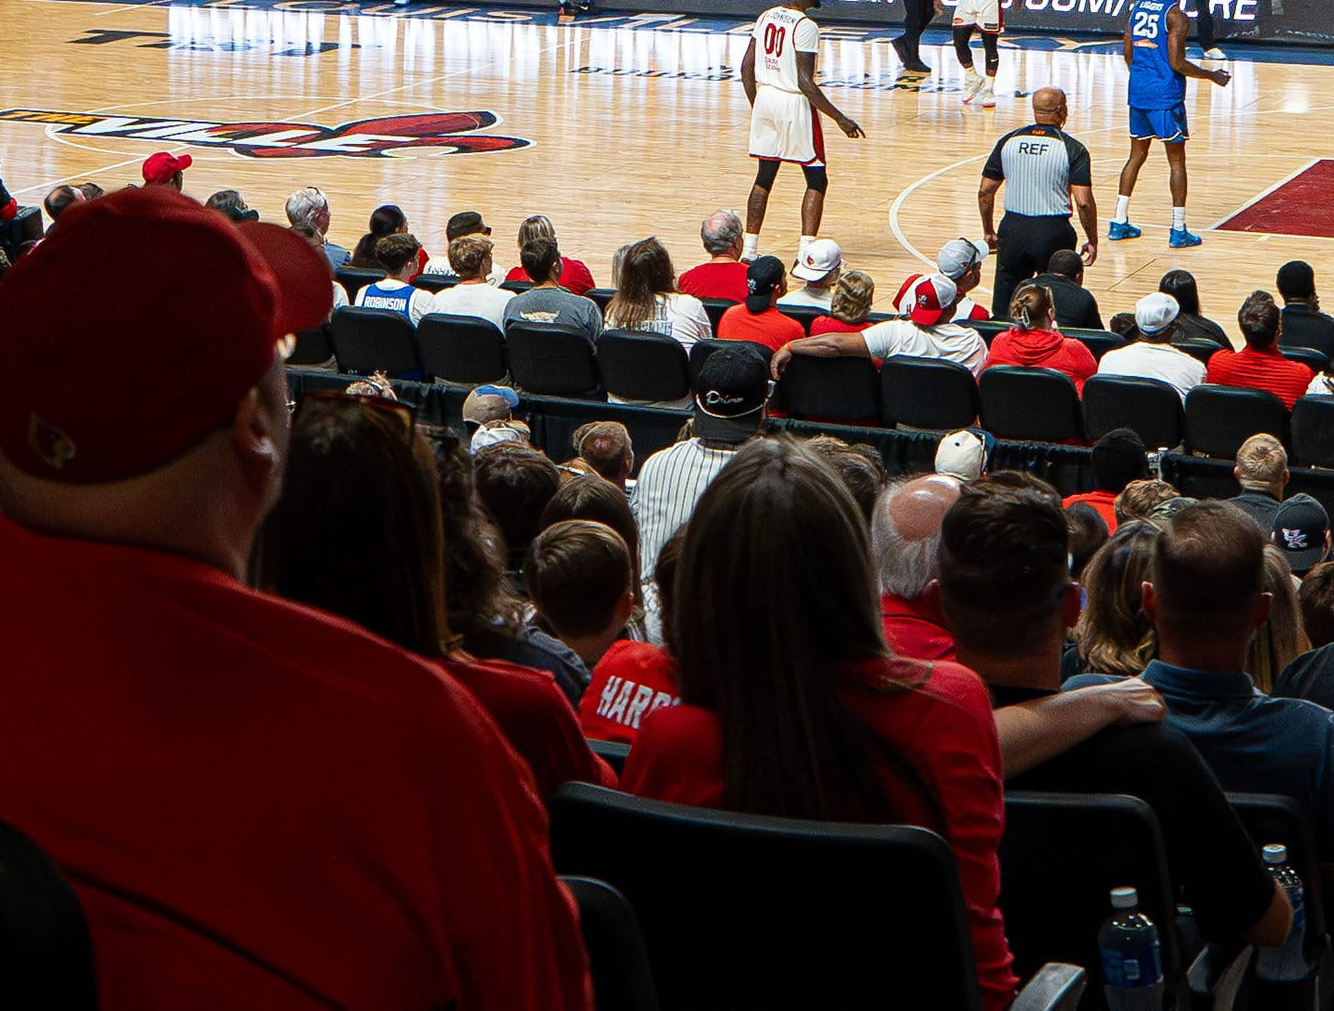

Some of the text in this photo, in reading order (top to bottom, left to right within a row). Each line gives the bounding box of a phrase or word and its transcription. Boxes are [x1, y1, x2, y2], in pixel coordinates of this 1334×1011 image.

[1132, 11, 1161, 39] 25
[764, 22, 786, 59] 00
[1018, 141, 1049, 156] REF
[364, 295, 408, 312] ROBINSON
[706, 390, 744, 406] Prime
[596, 674, 681, 730] HAR
